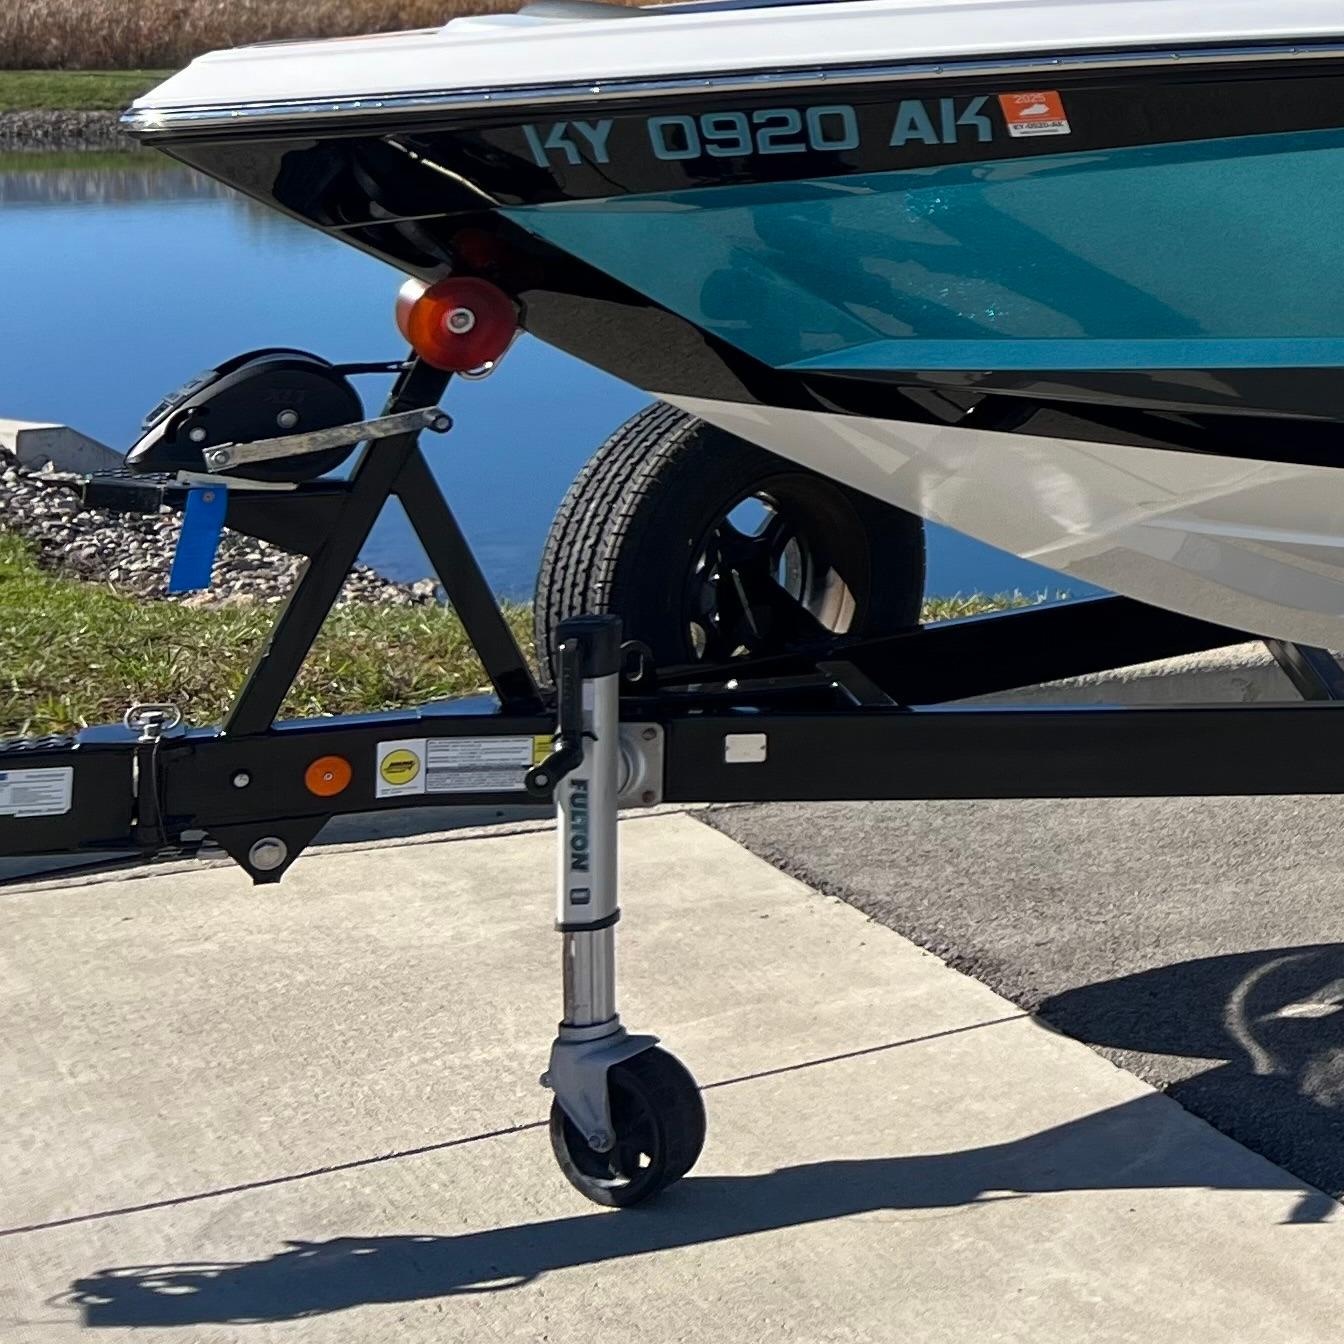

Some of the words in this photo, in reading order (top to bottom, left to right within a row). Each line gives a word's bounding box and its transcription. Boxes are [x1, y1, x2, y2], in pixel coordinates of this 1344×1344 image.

[522, 119, 614, 168] KY
[646, 105, 860, 161] 0920
[890, 96, 993, 146] AK
[569, 778, 590, 873] FULTON
